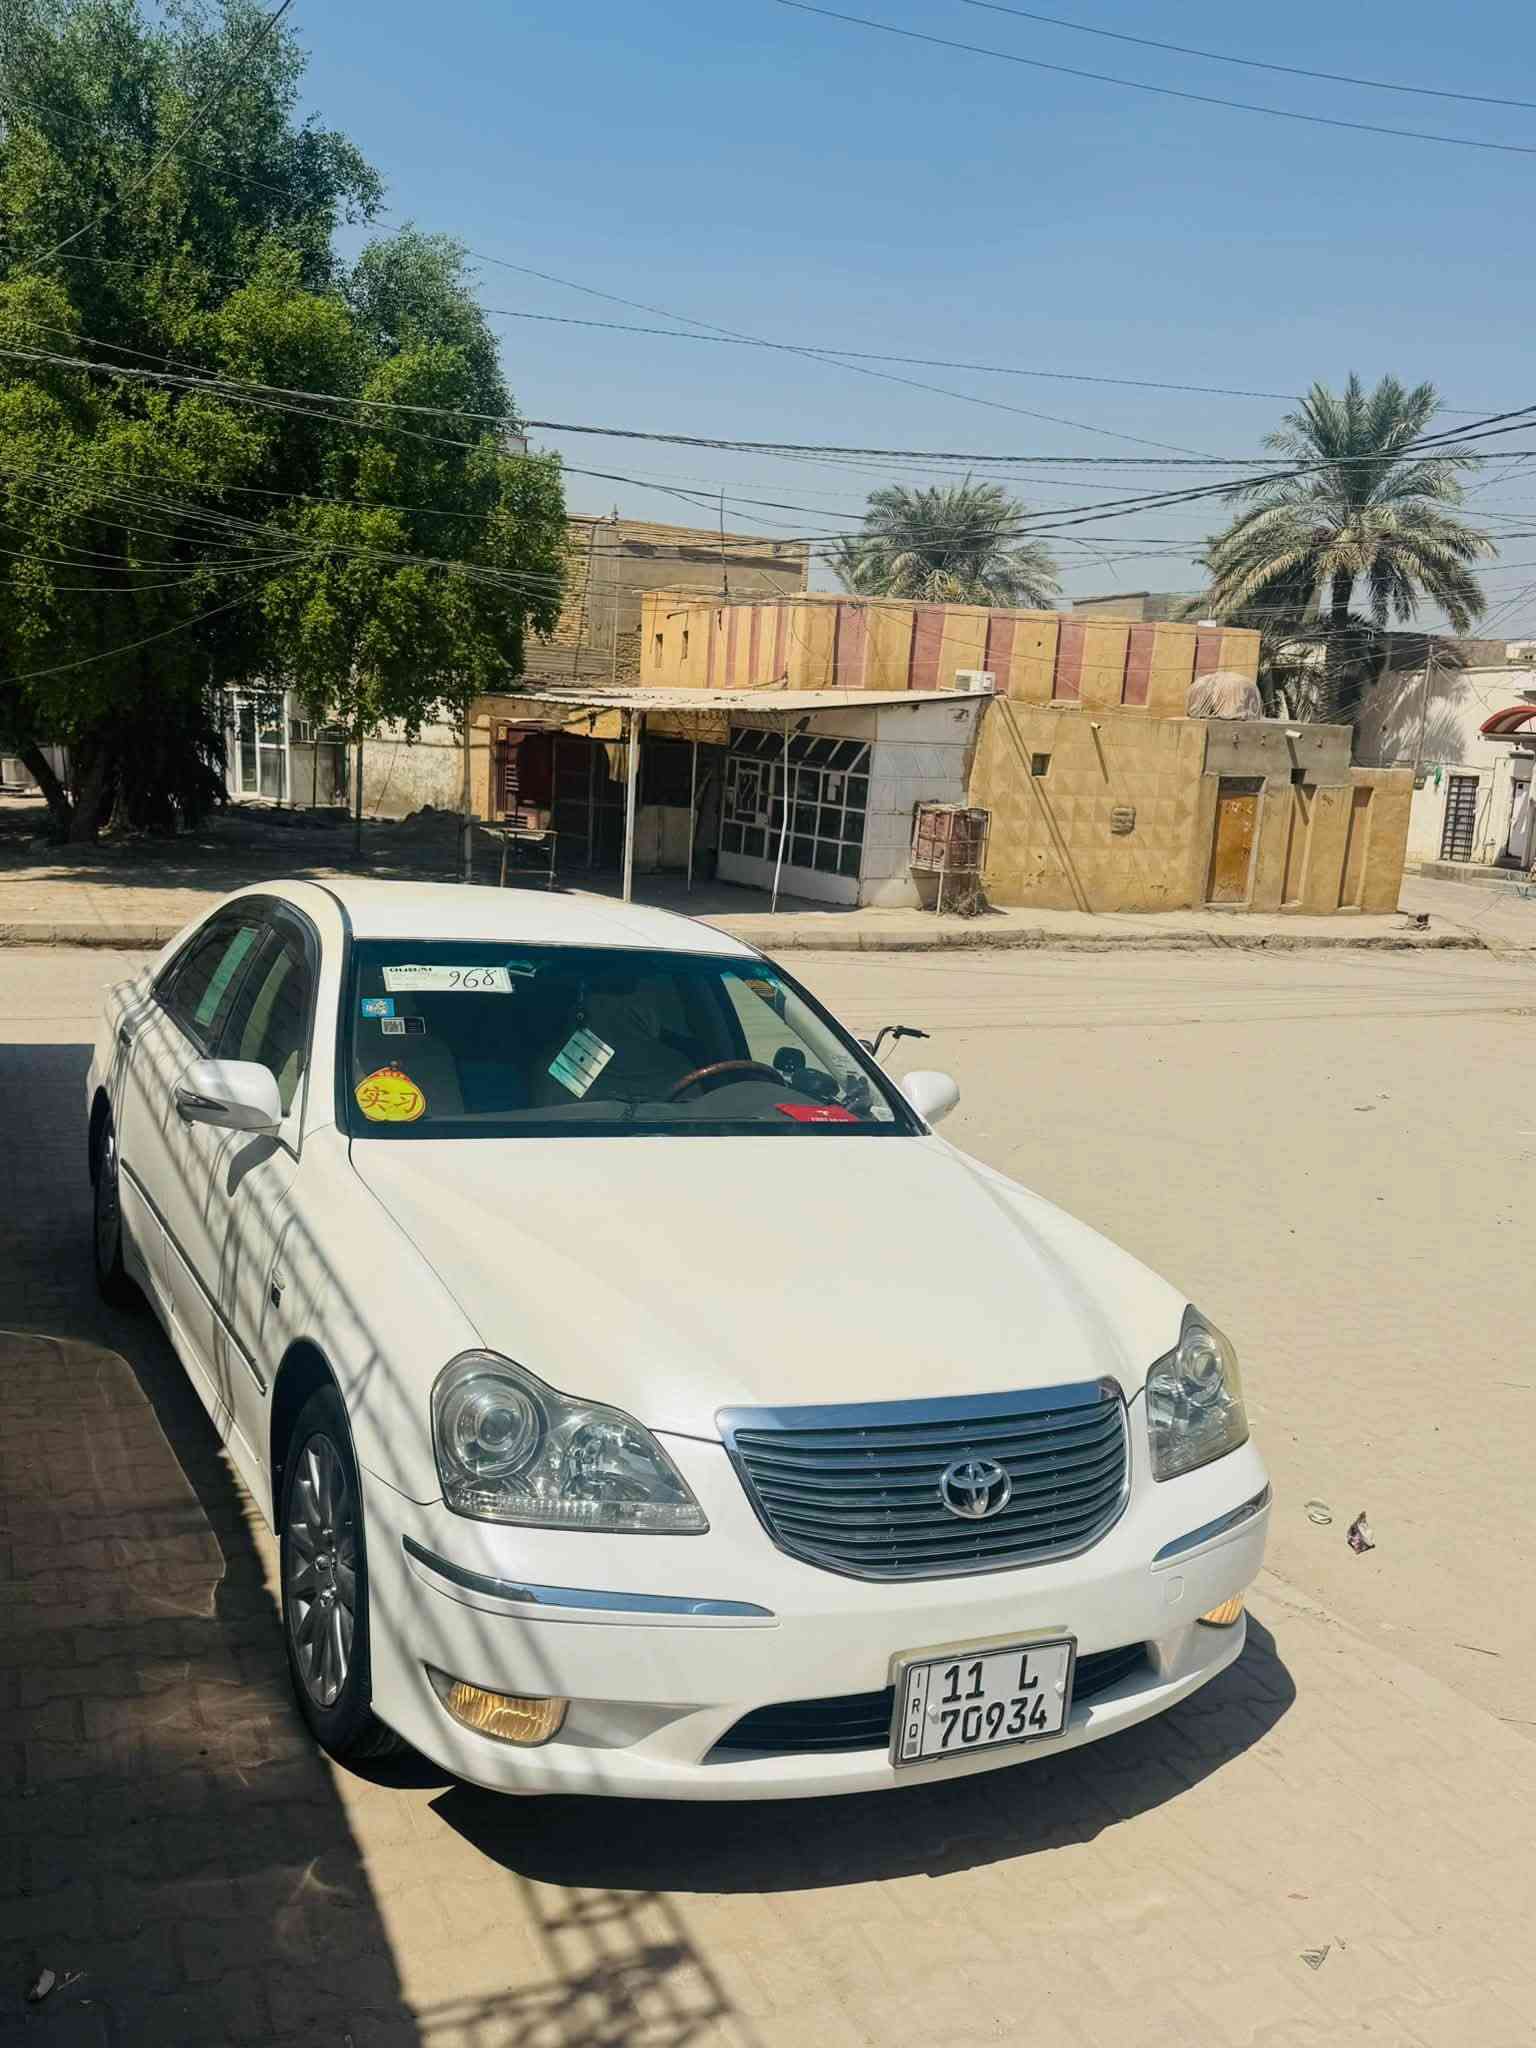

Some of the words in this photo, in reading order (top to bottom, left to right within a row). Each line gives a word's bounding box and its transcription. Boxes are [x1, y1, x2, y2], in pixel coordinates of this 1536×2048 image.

[448, 968, 497, 989] 968
[360, 1085, 418, 1114] 实习
[942, 1661, 985, 1704] 11
[1018, 1654, 1039, 1691] L
[940, 1693, 1048, 1748] 70934
